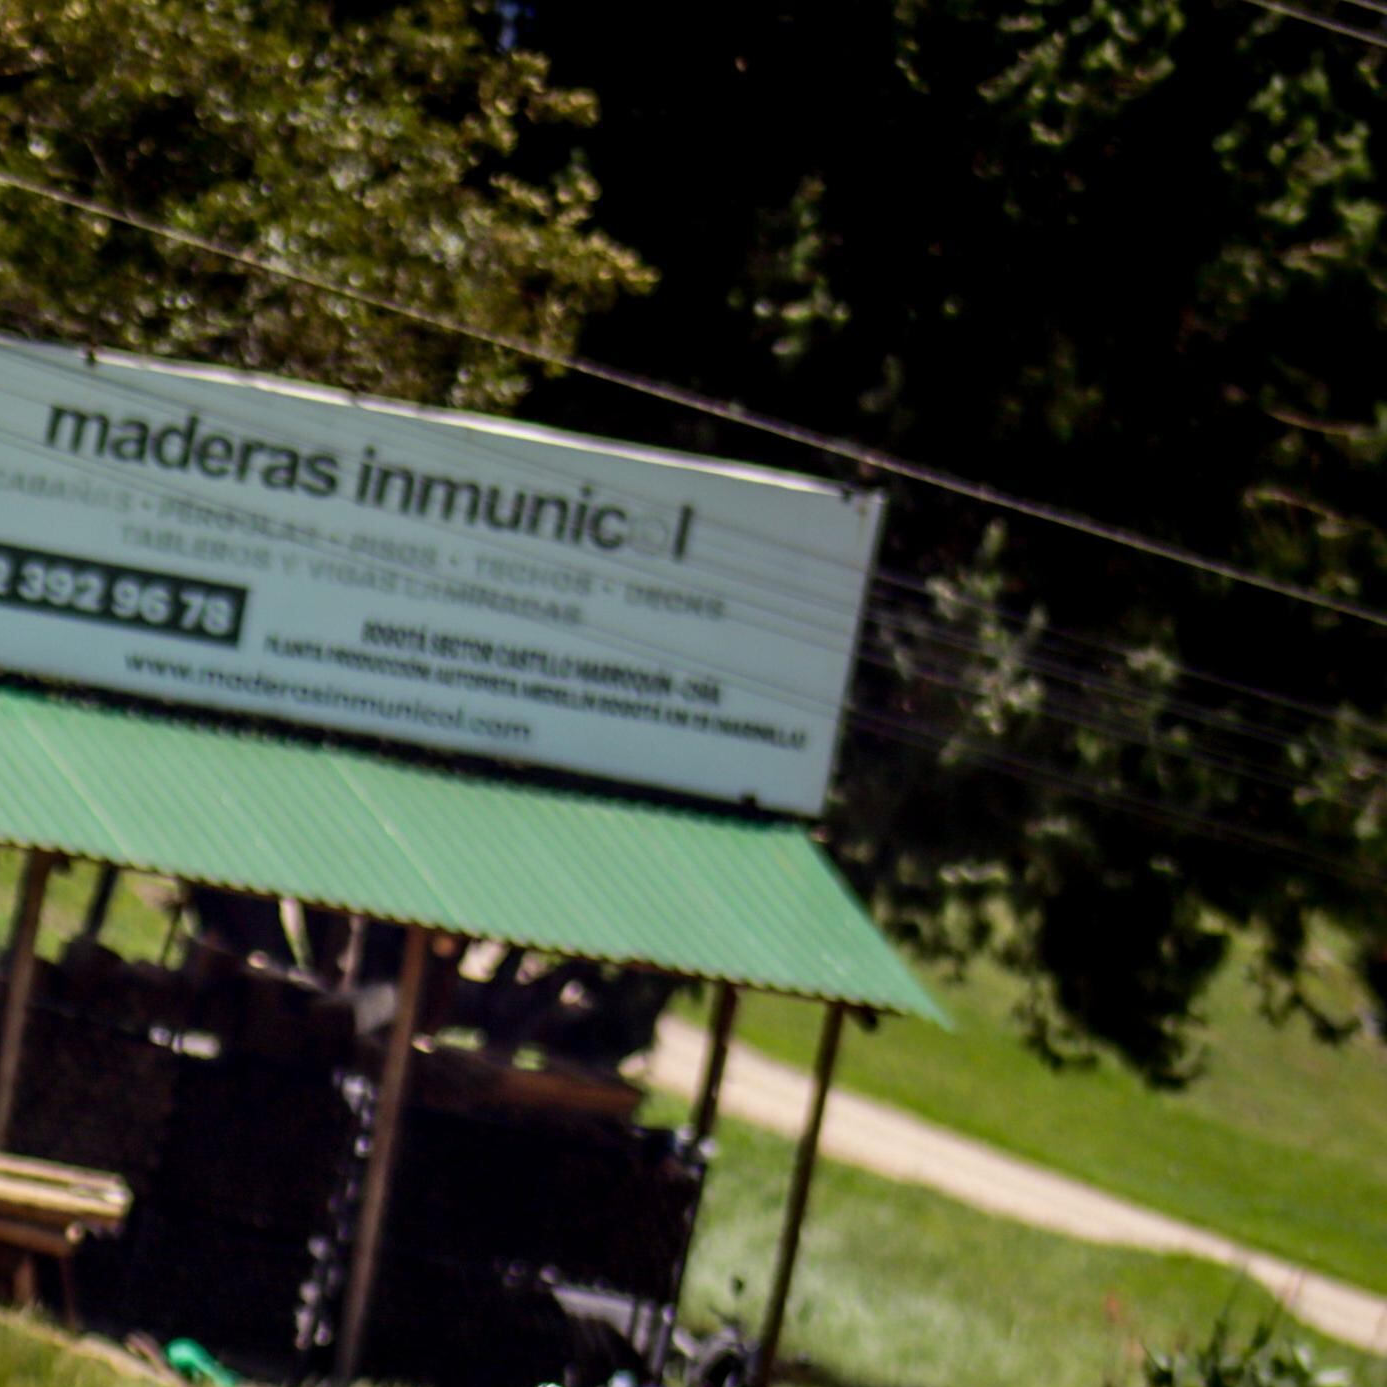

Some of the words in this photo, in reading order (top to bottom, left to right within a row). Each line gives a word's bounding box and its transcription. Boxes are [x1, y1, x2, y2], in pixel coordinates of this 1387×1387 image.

[43, 404, 340, 498] maderas
[355, 446, 694, 562] inmunicl
[17, 560, 105, 613] 392
[110, 577, 174, 625] 96
[178, 589, 235, 637] 78
